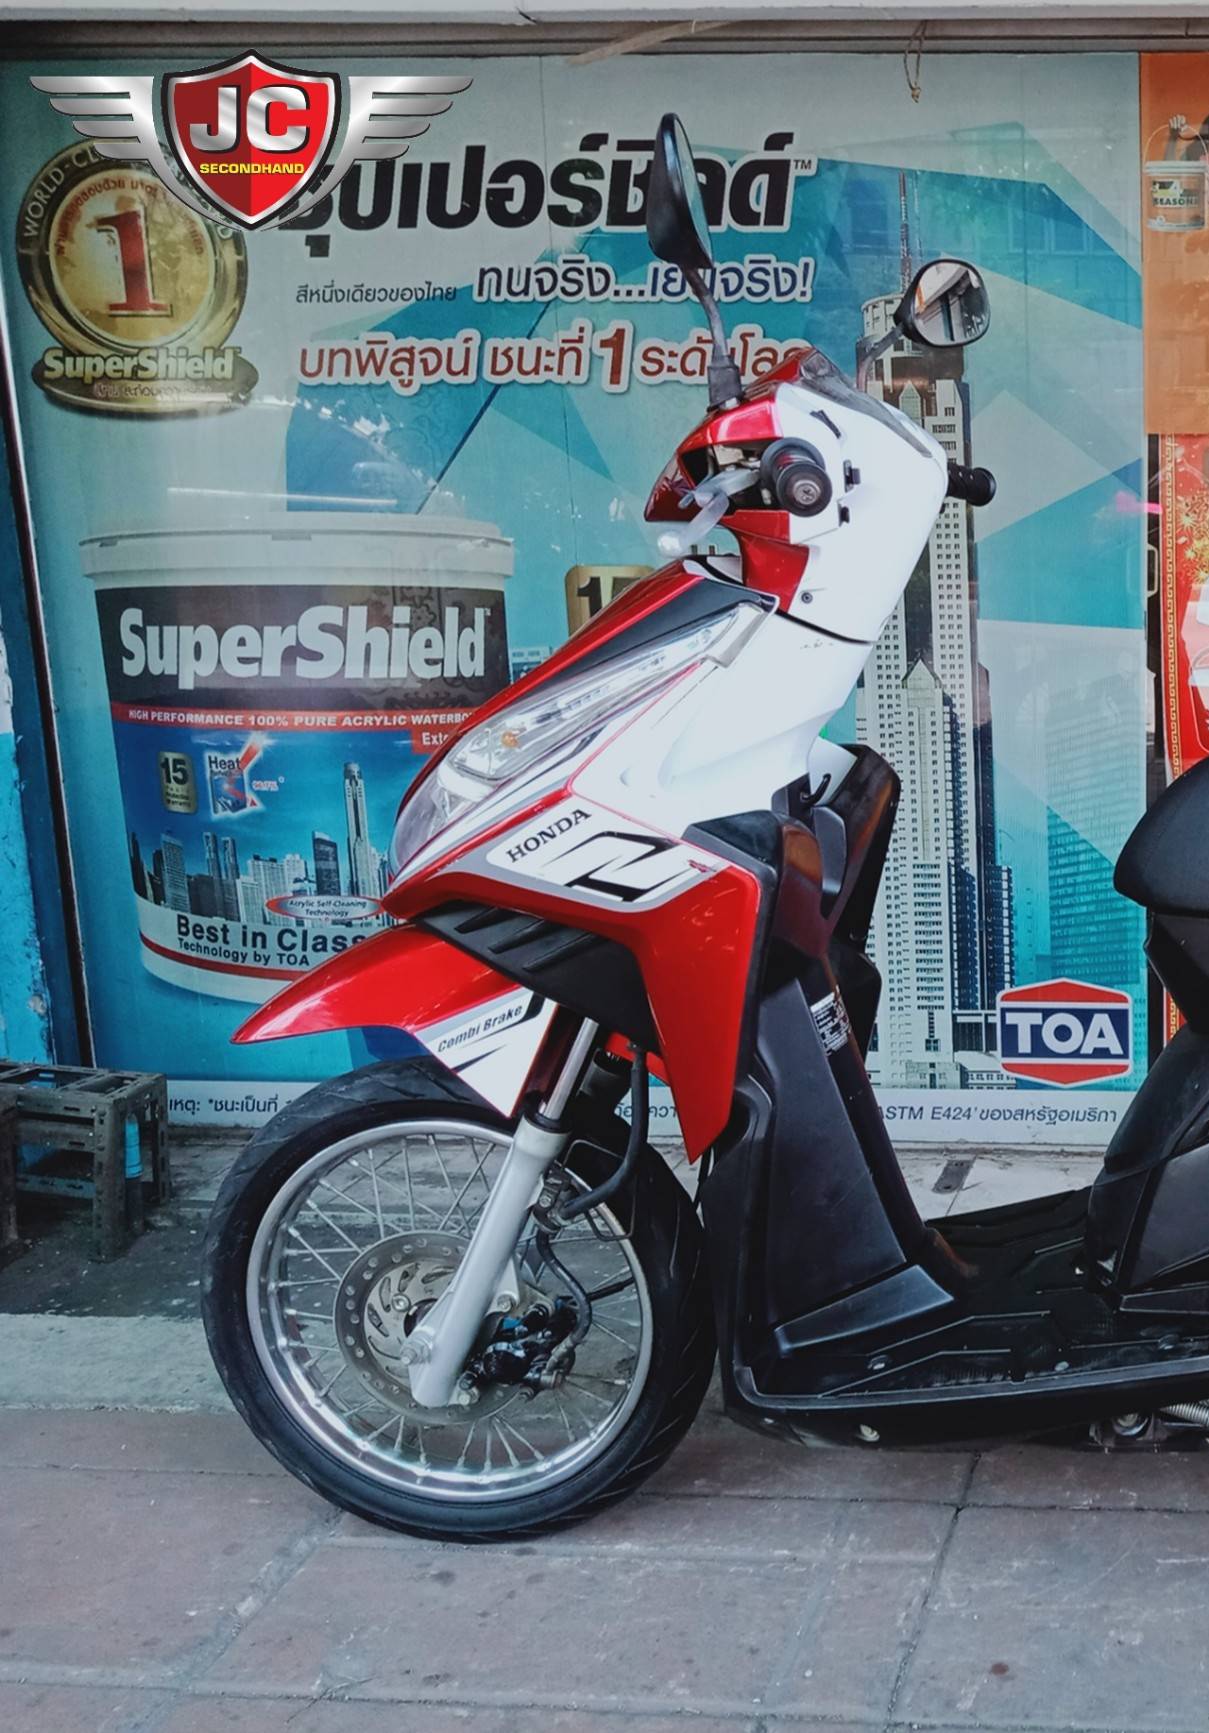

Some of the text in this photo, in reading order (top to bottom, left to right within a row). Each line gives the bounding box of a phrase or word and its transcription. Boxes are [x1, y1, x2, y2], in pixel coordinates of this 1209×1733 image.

[97, 210, 171, 314] 1
[476, 257, 812, 300] ทนจริง...เยจริง!
[295, 280, 457, 304] สีหนึ่งเดียวของไทย
[44, 348, 235, 382] SuperShield
[300, 333, 474, 389] บทพิสูจน์
[490, 326, 588, 380] ชนะที่
[598, 327, 629, 386] 1
[120, 605, 487, 689] SuperShield
[128, 710, 474, 727] HIGH PERFORMANCE 100% PURE ACRYLIC WATERBO
[161, 757, 189, 785] 15
[208, 755, 241, 770] Heat
[506, 808, 592, 863] HONDA
[177, 914, 367, 953] Best in Class
[178, 937, 310, 966] Technology by TOA
[438, 1005, 523, 1052] Combi Brake
[1005, 1012, 1124, 1055] TOA
